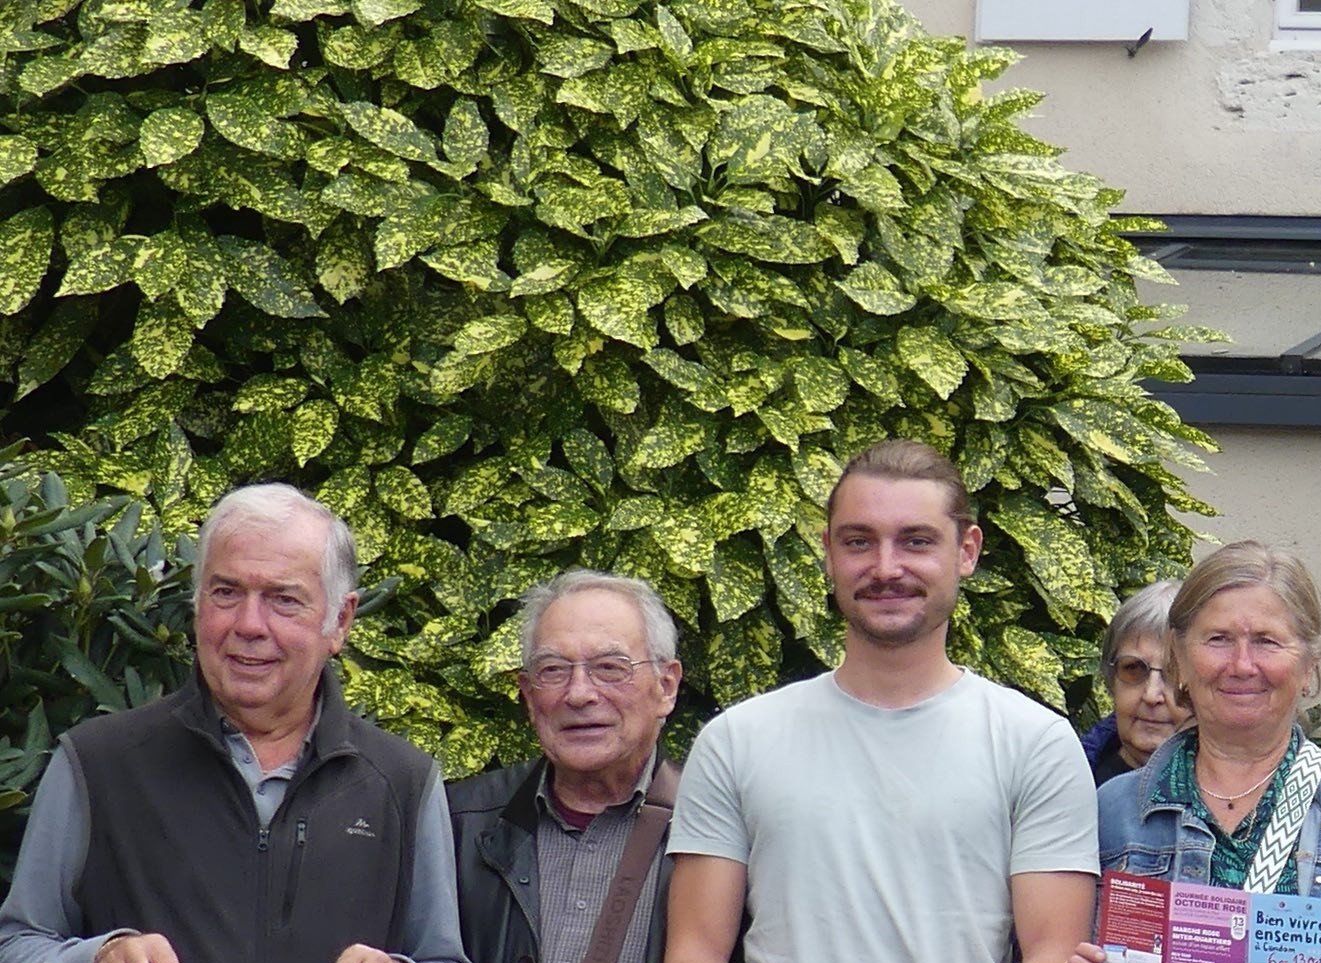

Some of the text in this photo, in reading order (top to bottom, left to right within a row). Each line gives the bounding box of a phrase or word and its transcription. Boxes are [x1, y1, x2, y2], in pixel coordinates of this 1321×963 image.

[1174, 898, 1248, 914] OCTOBRE ROSE
[1256, 910, 1284, 928] Bien
